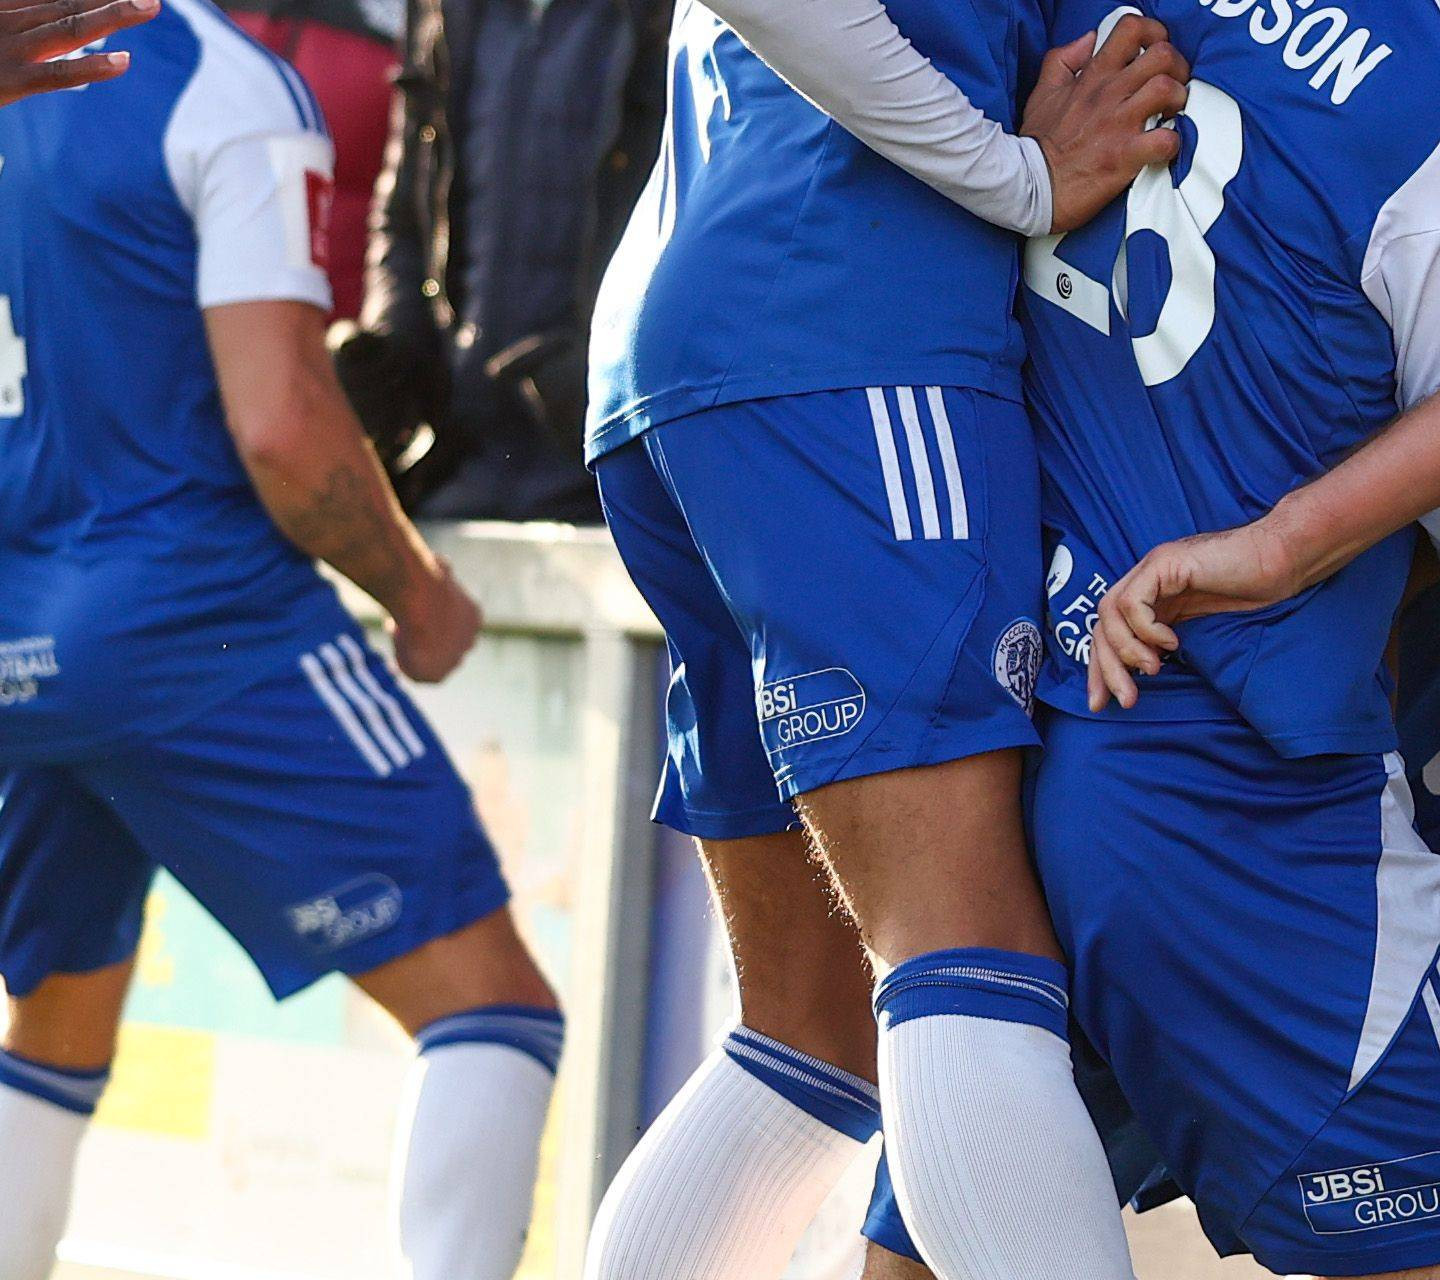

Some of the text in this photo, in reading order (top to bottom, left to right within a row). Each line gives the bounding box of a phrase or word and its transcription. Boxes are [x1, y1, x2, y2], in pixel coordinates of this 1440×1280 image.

[761, 682, 796, 718] BSi
[776, 701, 858, 743] GROUP
[1306, 1167, 1385, 1203] JBSi
